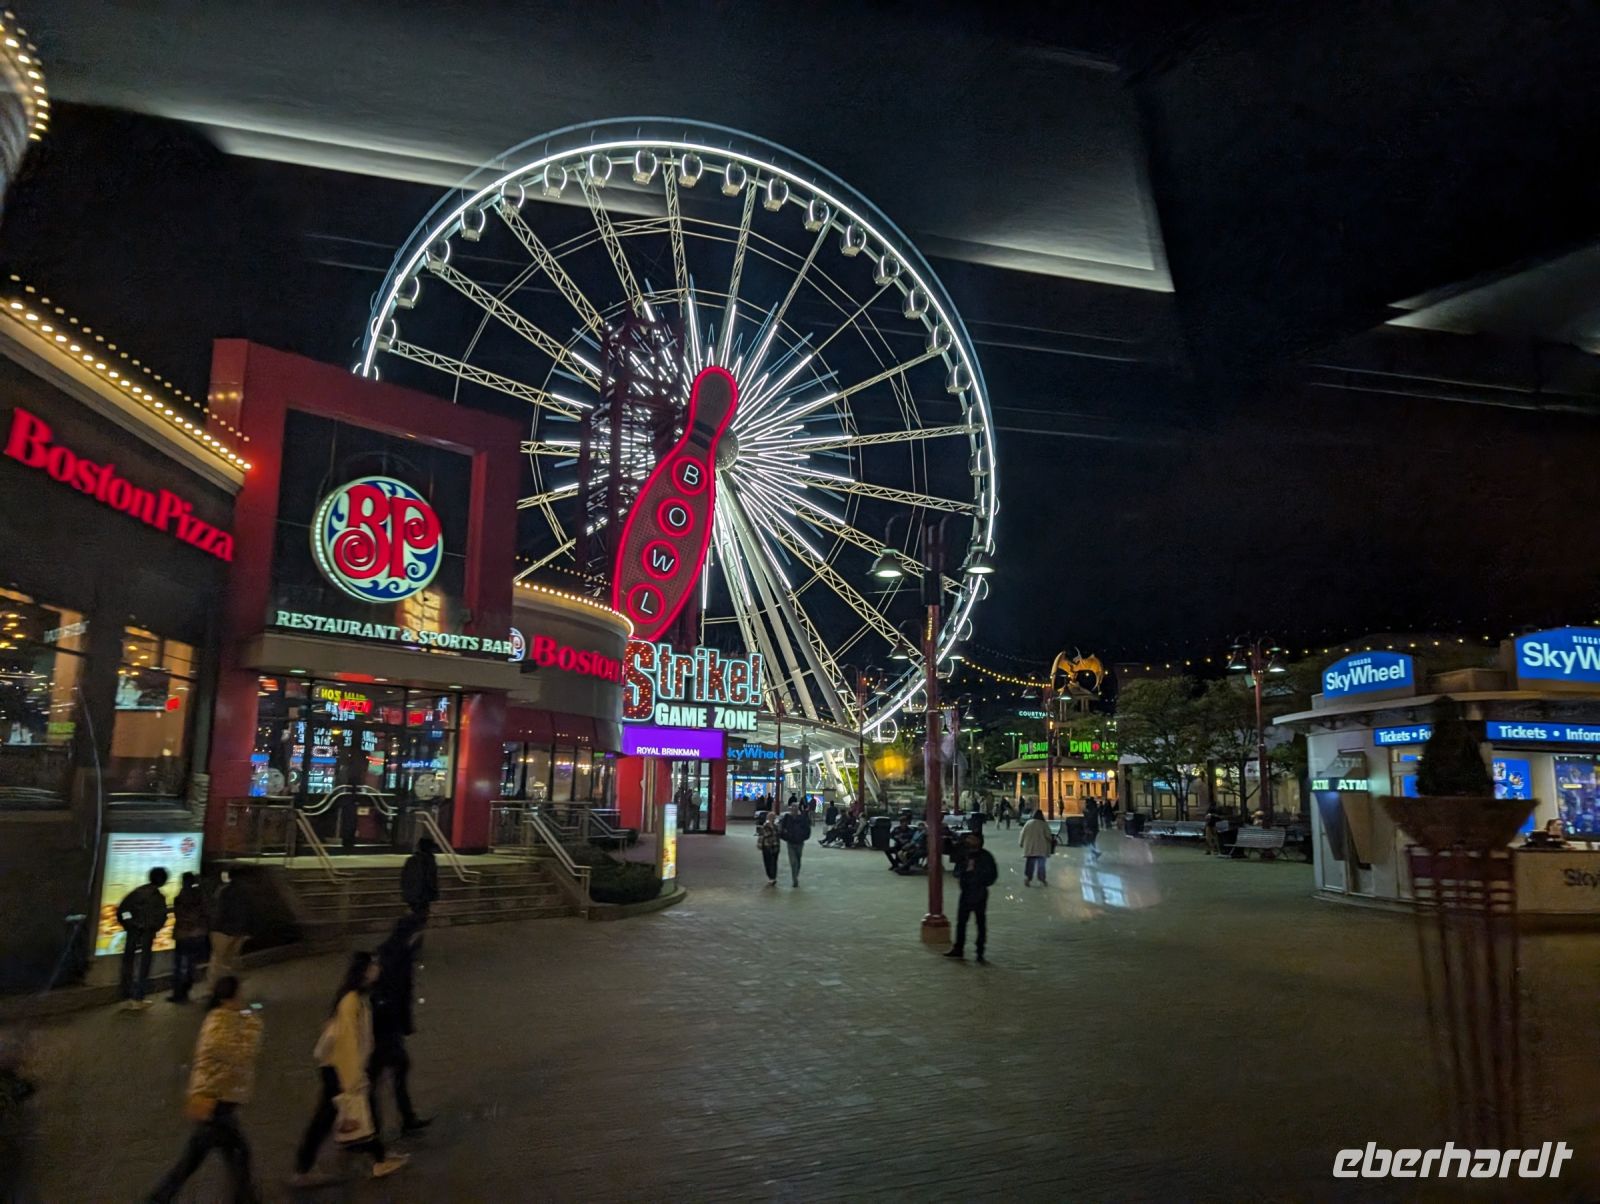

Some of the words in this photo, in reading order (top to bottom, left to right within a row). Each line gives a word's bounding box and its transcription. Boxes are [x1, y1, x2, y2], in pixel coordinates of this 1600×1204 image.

[333, 484, 442, 580] BP
[275, 611, 401, 640] RESTAURANT
[401, 629, 413, 643] &
[418, 631, 479, 650] SPORTS
[482, 638, 512, 655] BAR
[623, 639, 763, 723] Strike!
[1326, 659, 1405, 691] SkyWheel
[655, 703, 708, 728] GAME
[714, 706, 758, 731] ZONE
[1379, 731, 1411, 742] Tickets
[1498, 725, 1547, 739] Tickets
[637, 746, 661, 756] ROYAL
[661, 747, 700, 757] BRINKMAN
[728, 747, 785, 761] kyWheel
[1337, 779, 1368, 791] ATM
